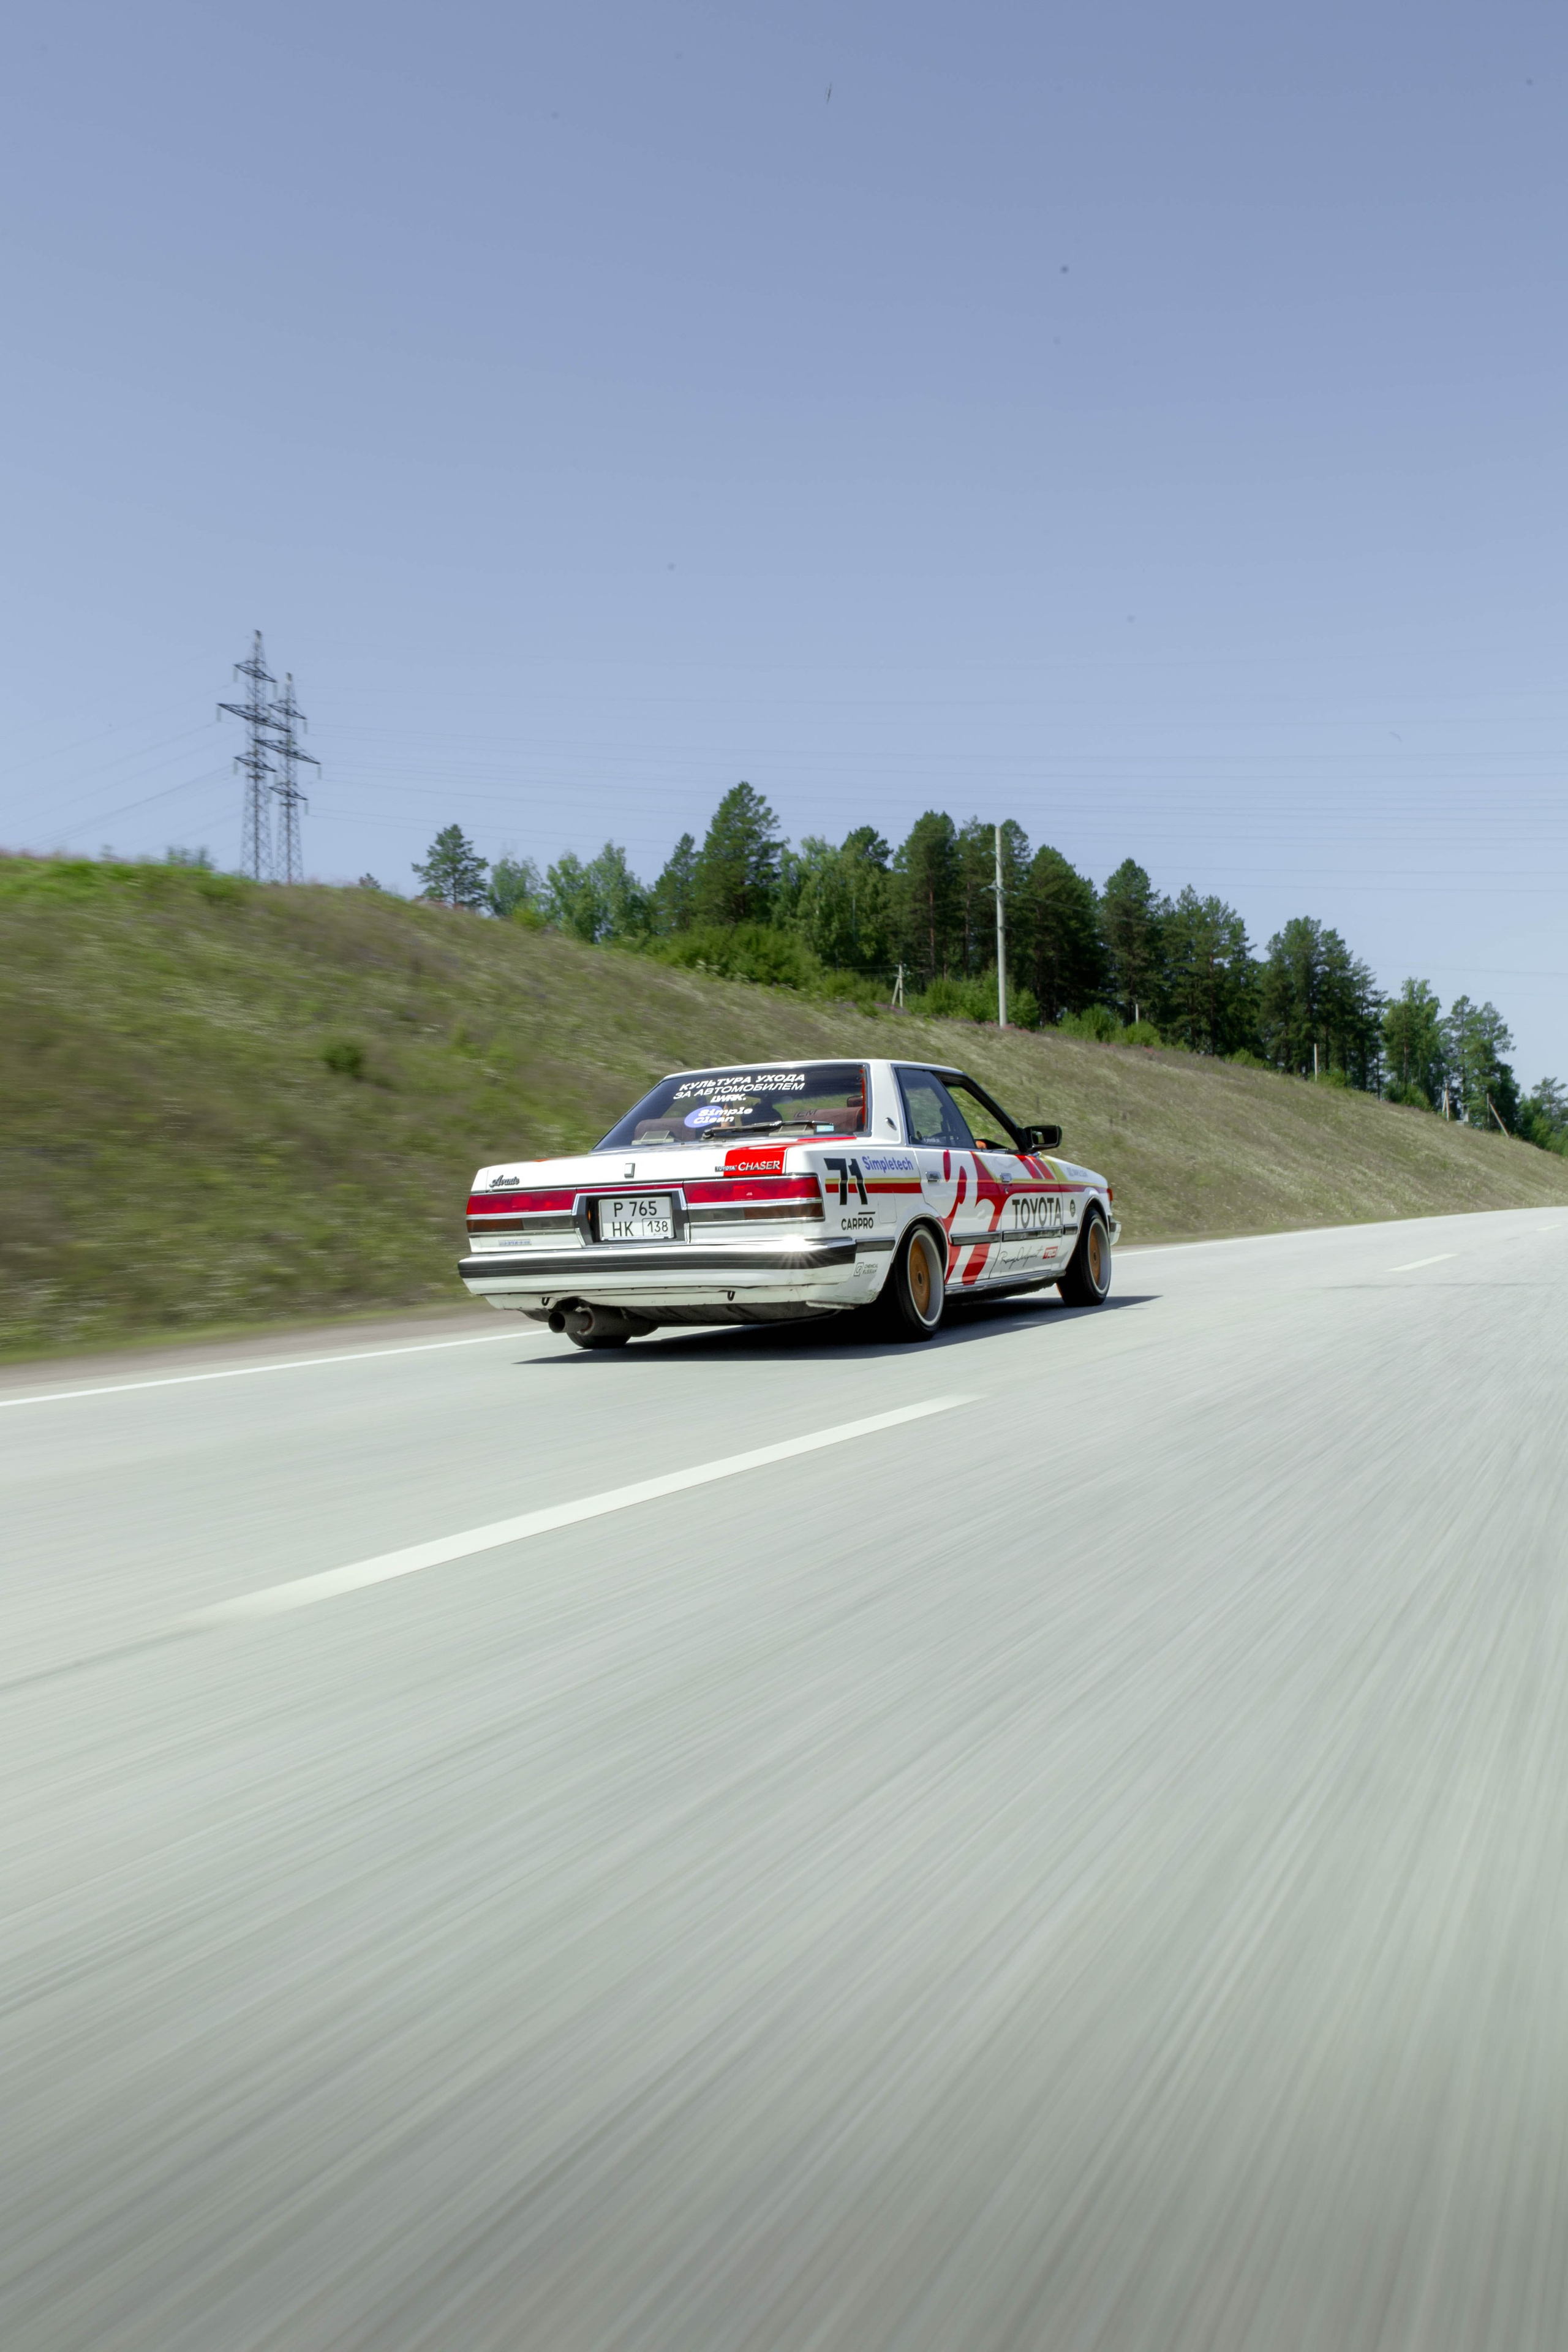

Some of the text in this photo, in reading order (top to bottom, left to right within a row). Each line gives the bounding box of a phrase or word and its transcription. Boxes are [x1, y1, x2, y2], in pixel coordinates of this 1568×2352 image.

[679, 1074, 805, 1091] КУЛЬТУРА УХОДА
[694, 1082, 805, 1096] АВТОМОБИЛЕМ
[698, 1106, 753, 1117] Simple
[693, 1116, 735, 1125] Clean
[737, 1160, 781, 1171] CHASER
[862, 1156, 914, 1173] Simpletech
[824, 1158, 868, 1205] 71
[629, 1200, 657, 1216] 765
[1012, 1197, 1062, 1229] TOYOTA
[647, 1221, 668, 1232] 138
[842, 1217, 873, 1231] CARPRO
